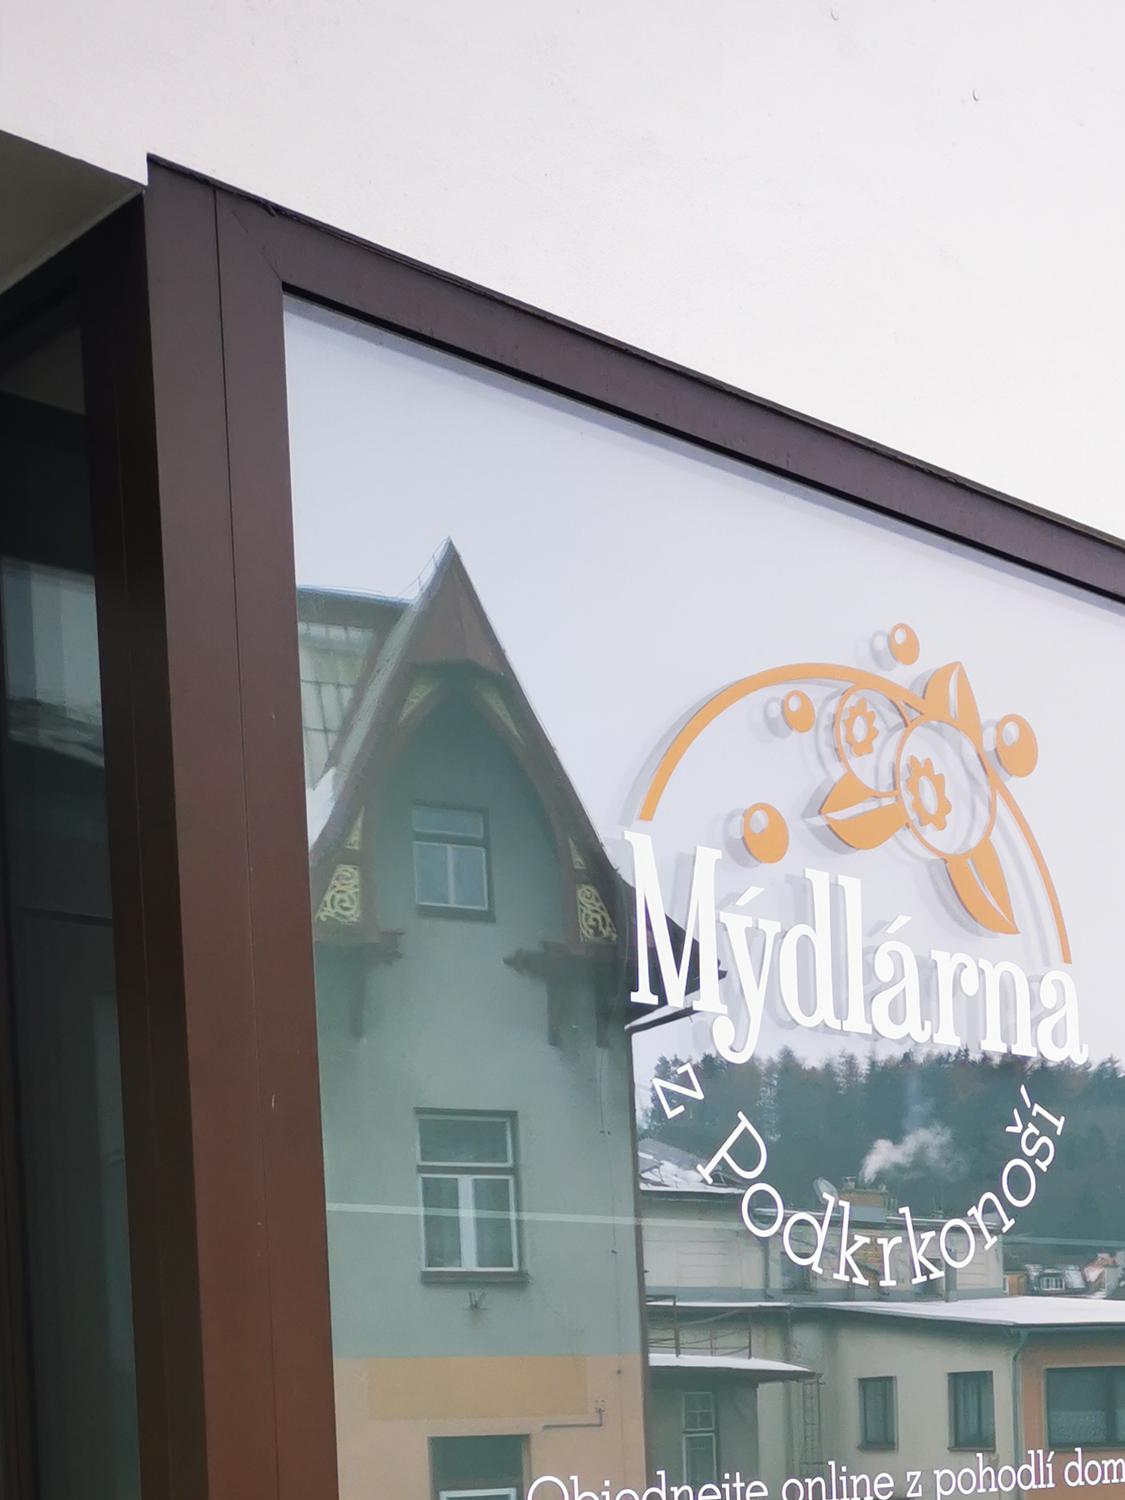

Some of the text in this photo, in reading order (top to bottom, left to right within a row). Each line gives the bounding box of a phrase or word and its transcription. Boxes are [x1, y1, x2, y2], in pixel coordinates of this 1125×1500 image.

[624, 831, 1088, 1065] Mýdlárna
[652, 1062, 1066, 1288] z Podkrkonoší
[906, 1471, 923, 1497] z
